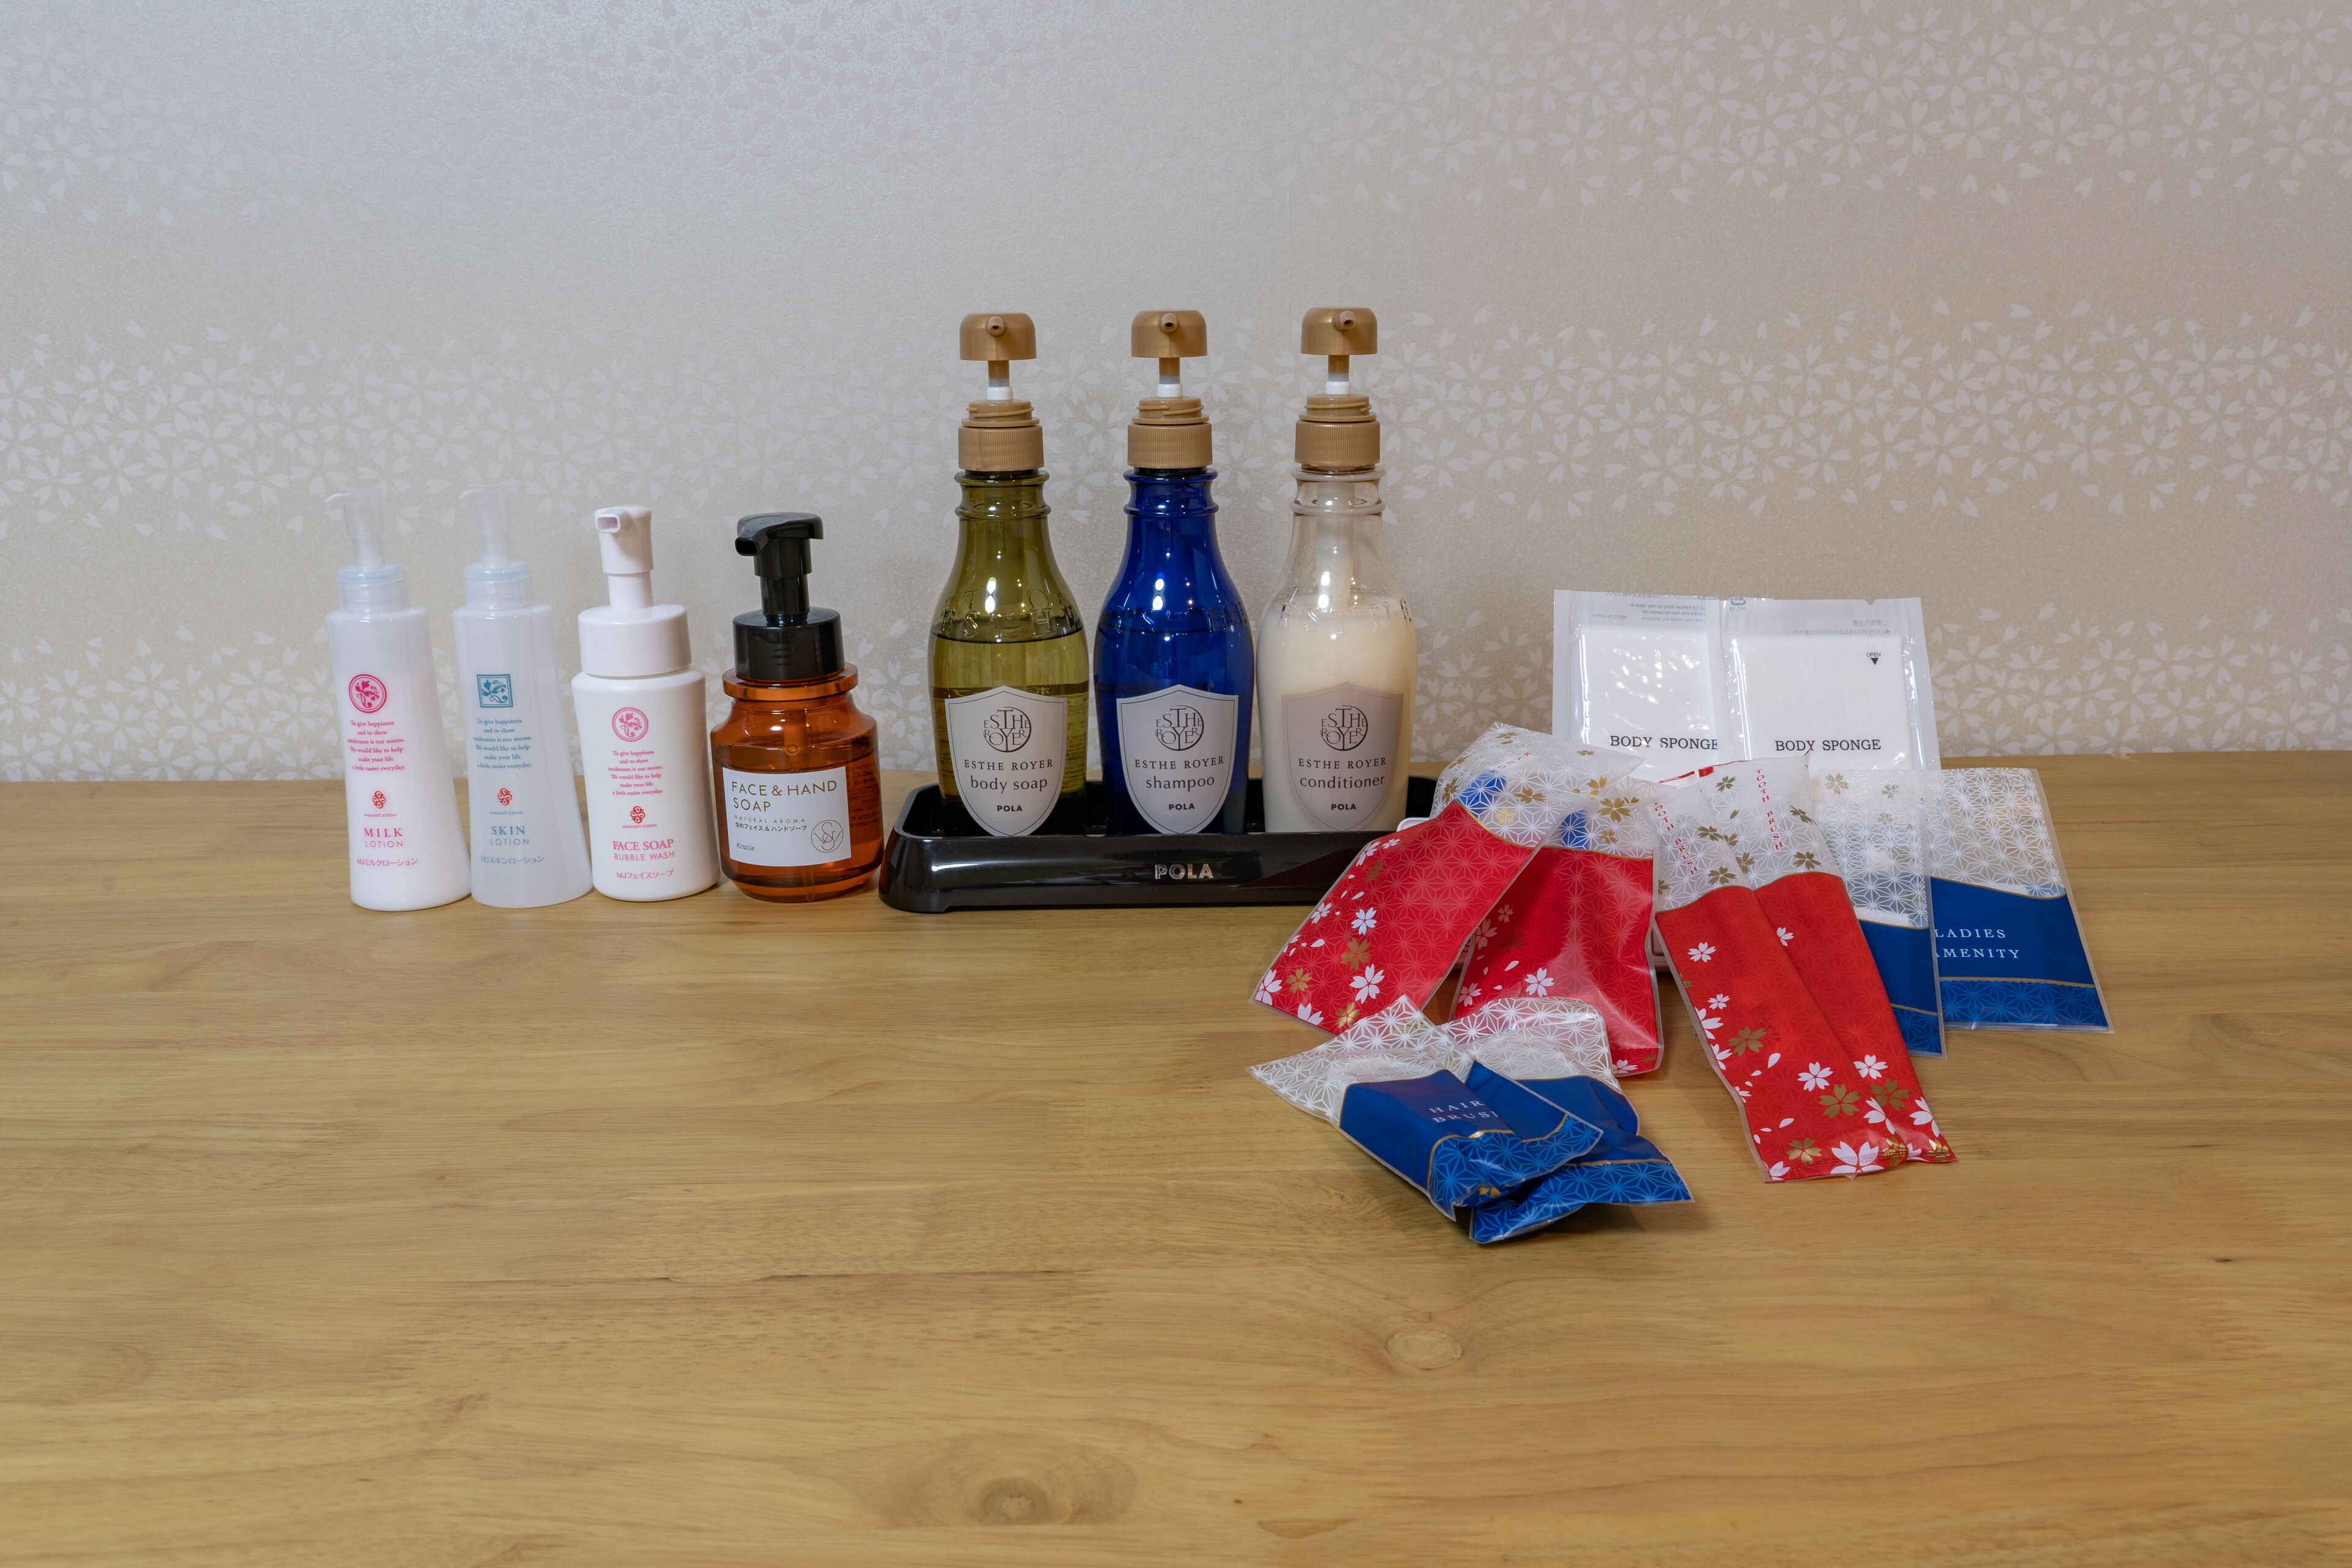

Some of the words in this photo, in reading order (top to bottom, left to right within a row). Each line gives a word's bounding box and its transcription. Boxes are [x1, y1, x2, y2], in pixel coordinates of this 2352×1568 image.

[1610, 736, 1653, 747] BODY
[1660, 737, 1718, 750] SPONGE
[1775, 740, 1815, 751] BODY
[1822, 739, 1882, 750] SPONGE
[964, 760, 1004, 771] ESTHE
[1011, 759, 1054, 771] ROYER
[1135, 760, 1176, 769] ESTHE
[1184, 756, 1224, 769] ROYER
[1298, 758, 1340, 769] ESTHE
[1347, 757, 1387, 769] ROYER
[731, 781, 767, 796] FACE
[771, 785, 783, 796] &
[787, 780, 837, 796] HAND
[971, 775, 1008, 794] body
[1013, 778, 1047, 792] soap
[1146, 776, 1215, 792] shampoo
[1300, 776, 1385, 789] conditioner
[1755, 769, 1770, 803] TOOTH
[733, 797, 771, 812] SOAP
[734, 815, 767, 823] NATURAL
[1655, 802, 1675, 832] OOTH
[364, 827, 403, 837] MILK
[491, 826, 526, 835] SKIN
[1766, 810, 1784, 852] BRUSH
[612, 840, 640, 851] FACE
[643, 839, 674, 851] SOAP
[737, 842, 755, 851] Kracie
[480, 856, 545, 864] MJスキンローション
[649, 851, 675, 860] WASH
[1675, 838, 1698, 875] BRUSH
[356, 858, 418, 867] MJミルクローション
[617, 869, 674, 880] MJフェイスソープ
[1155, 864, 1214, 880] POLA
[1934, 929, 2006, 938] LADIES
[1428, 1100, 1485, 1113] HAIR
